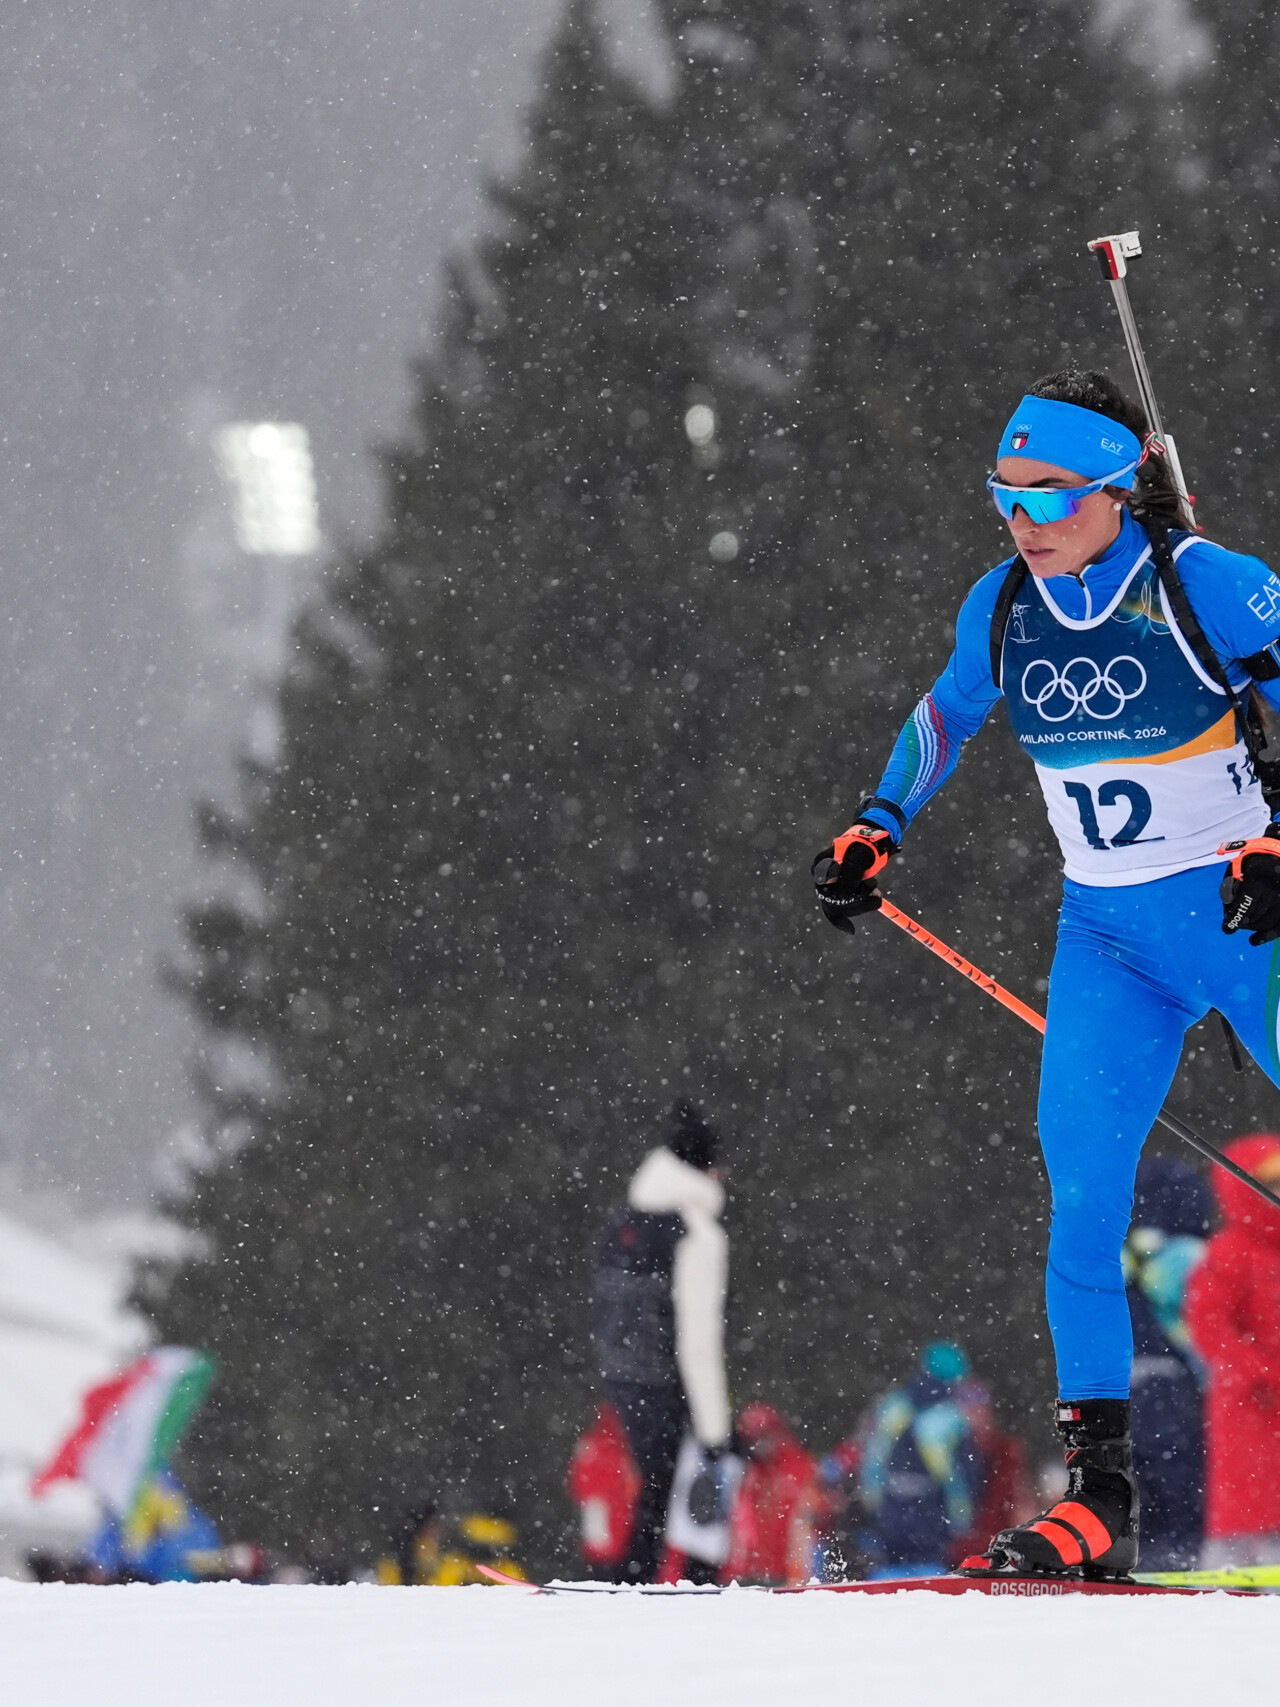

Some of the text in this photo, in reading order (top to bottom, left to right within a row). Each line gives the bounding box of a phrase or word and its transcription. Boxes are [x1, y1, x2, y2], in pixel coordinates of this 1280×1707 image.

[1101, 437, 1124, 453] EA7
[1019, 726, 1167, 744] MILANO CORTINA 2026
[1063, 779, 1166, 850] 12
[1228, 894, 1254, 930] sportful
